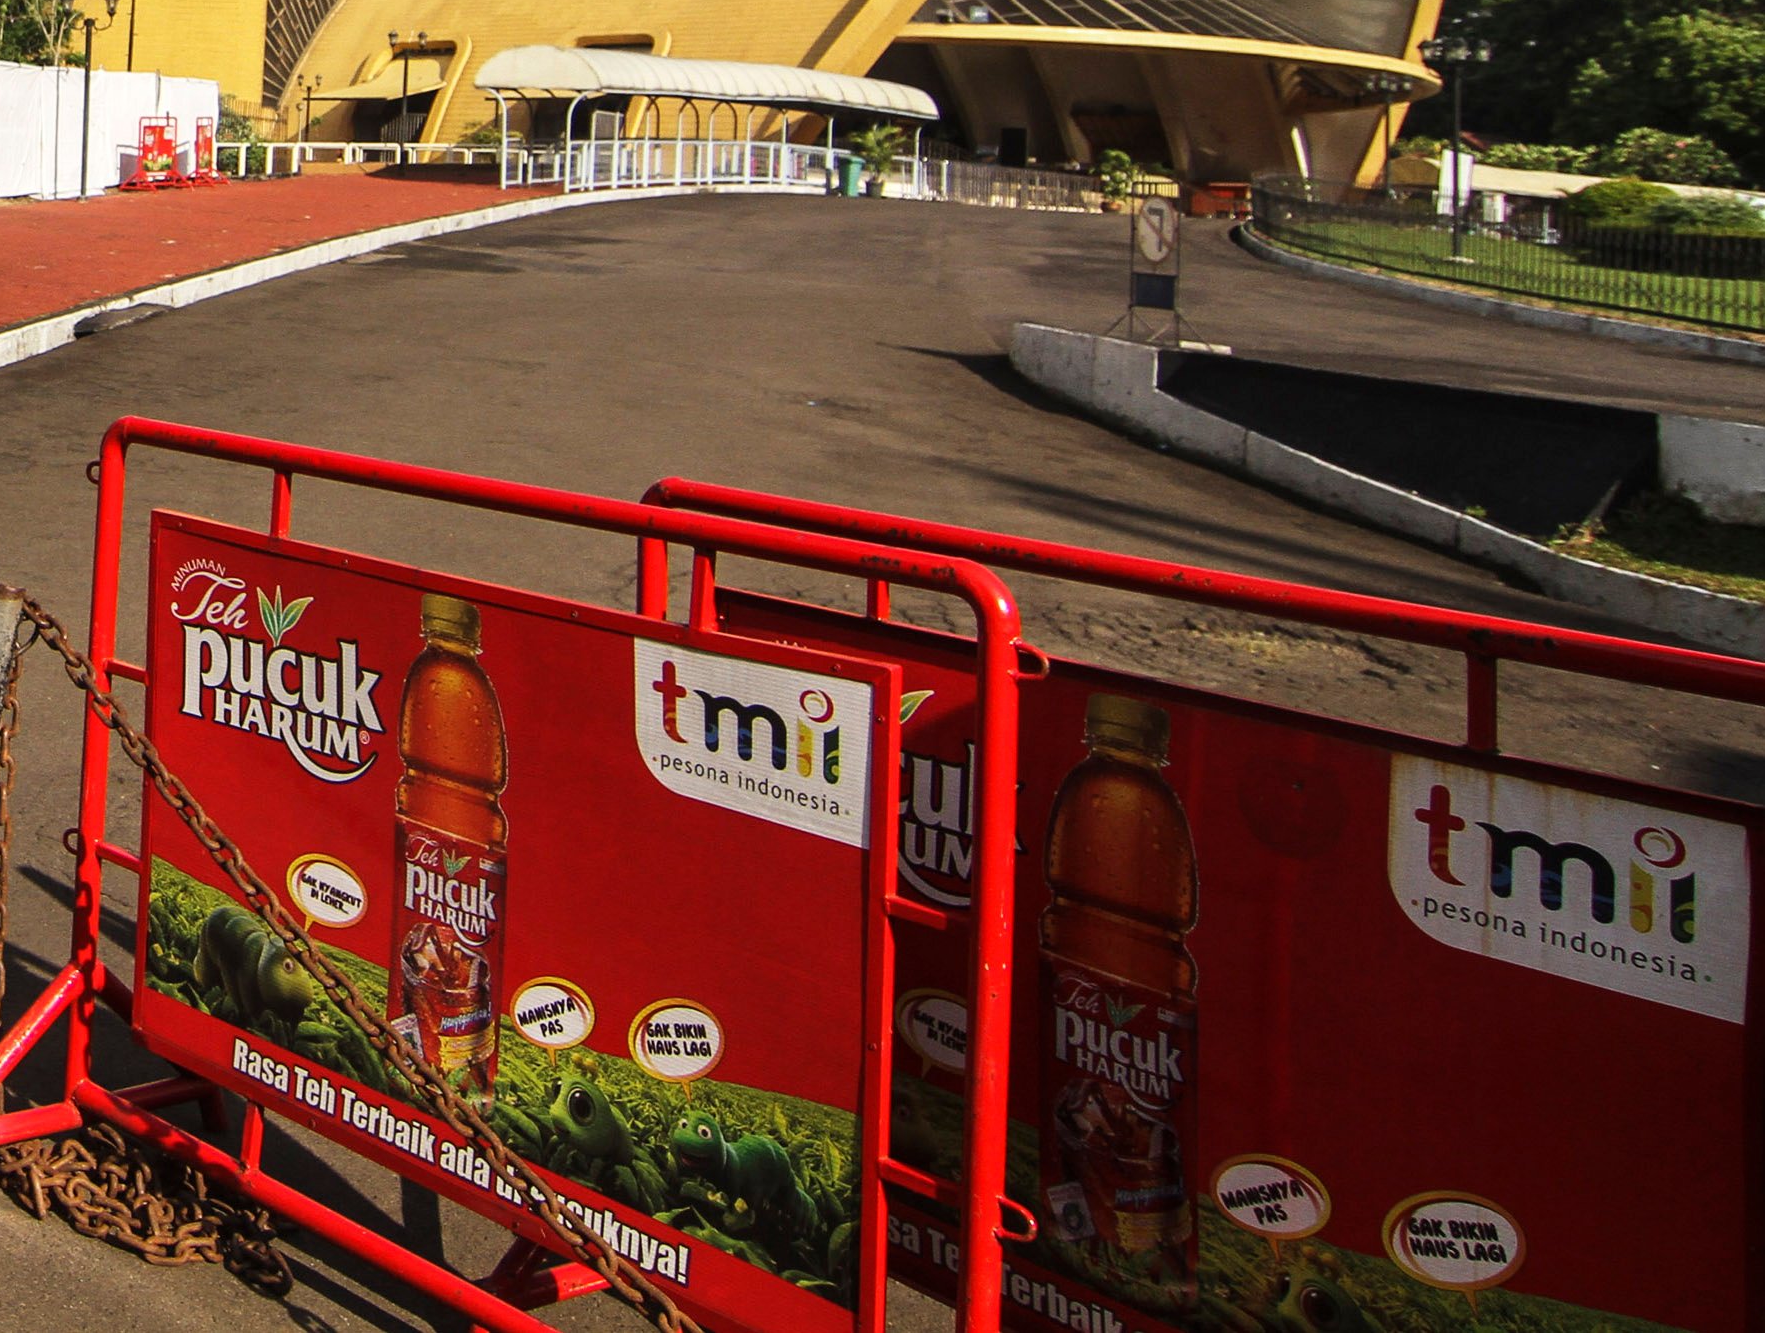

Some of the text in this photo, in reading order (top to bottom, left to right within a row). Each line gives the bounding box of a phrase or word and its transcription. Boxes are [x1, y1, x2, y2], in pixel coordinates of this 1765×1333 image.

[170, 558, 226, 592] MINUMAN
[170, 570, 249, 629] Teh
[213, 688, 377, 783] HARUM
[660, 753, 840, 816] pesona indonesia
[404, 835, 440, 867] Teh
[419, 895, 491, 946] HARUM
[1424, 896, 1697, 983] pesona indonesia
[1053, 976, 1101, 1014] Teh
[517, 997, 576, 1027] MANISNYA
[539, 1018, 564, 1038] PAS
[646, 1022, 708, 1040] GAK BIKIN
[646, 1039, 712, 1057] HAUS LAGI
[1076, 1047, 1173, 1111] HARUM
[232, 1037, 290, 1094] Rasa
[293, 1065, 337, 1116] Teh
[340, 1087, 436, 1164] Terbaik
[438, 1140, 492, 1190] ada
[1220, 1179, 1305, 1210] MANISNYA
[1253, 1203, 1289, 1225] PAS
[1407, 1216, 1500, 1242] GAK BIKIN
[1408, 1237, 1508, 1264] HAUS LAGI
